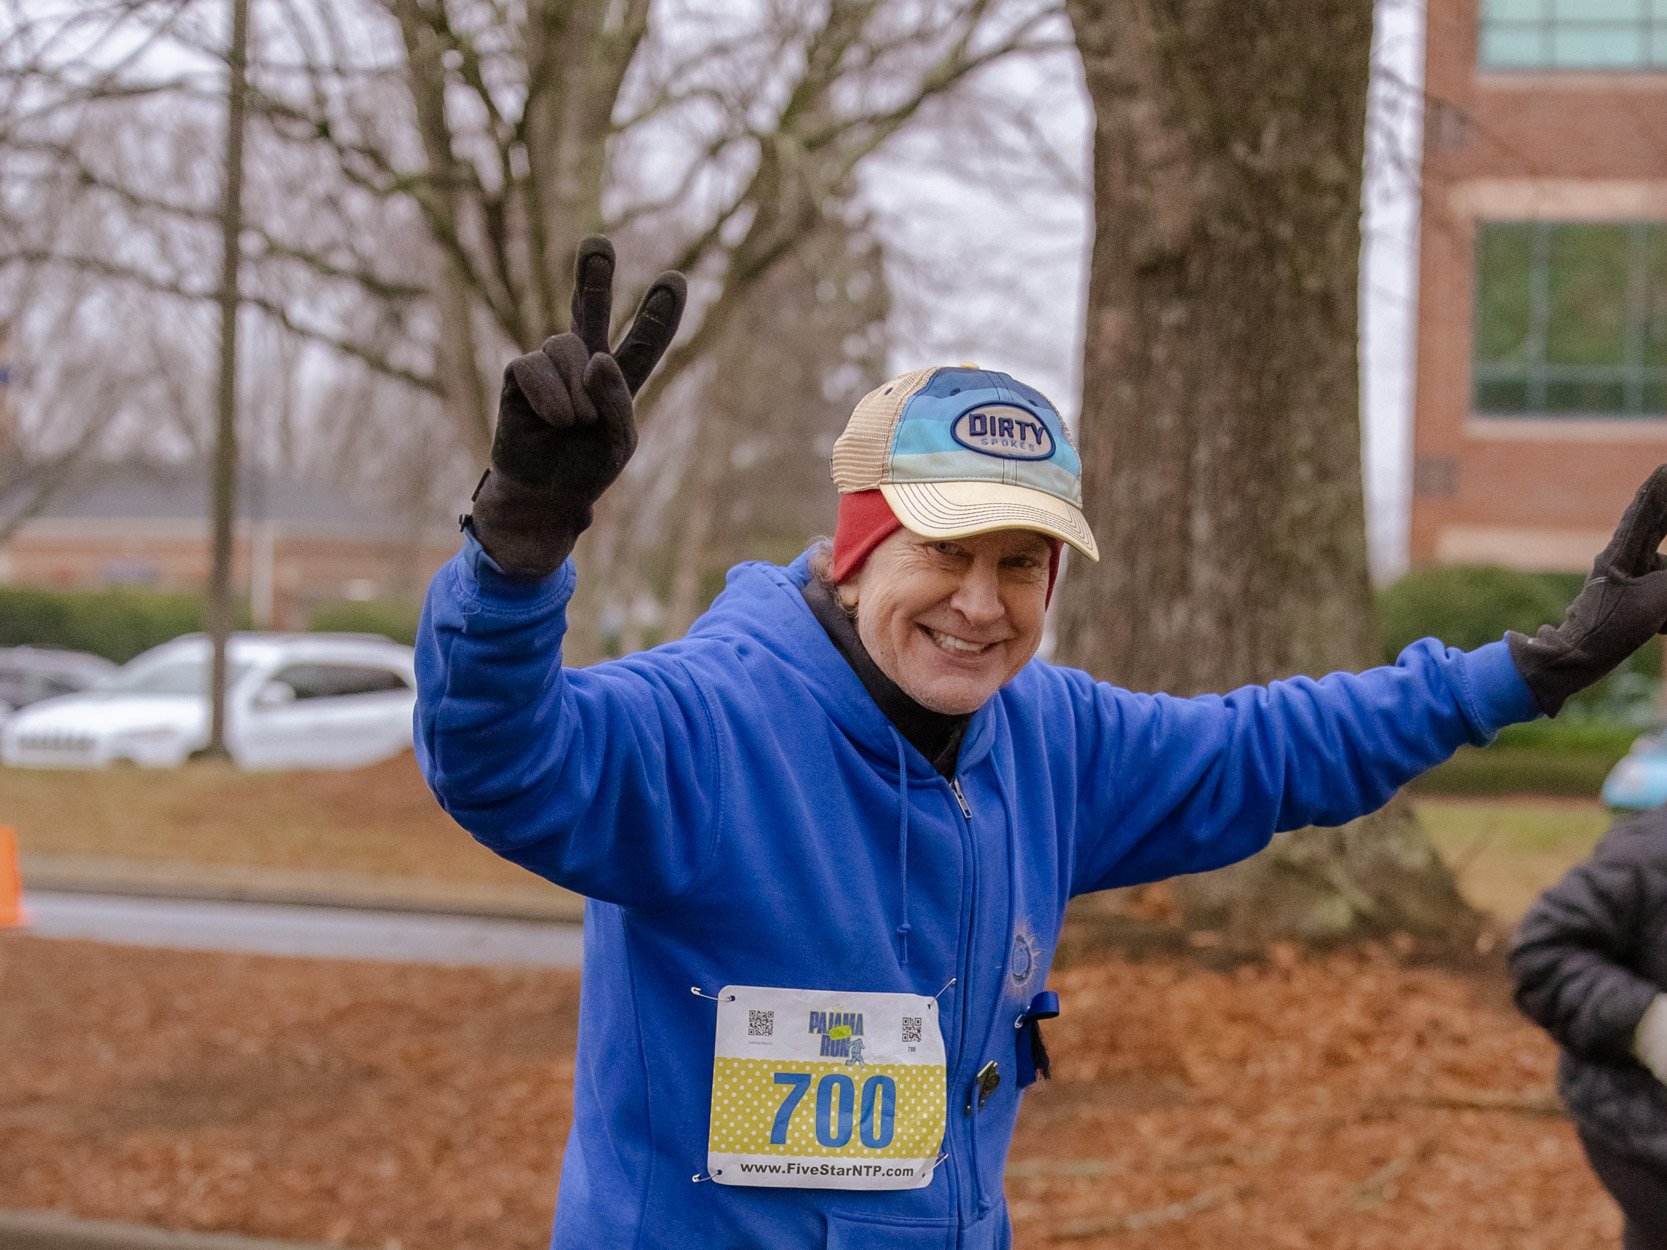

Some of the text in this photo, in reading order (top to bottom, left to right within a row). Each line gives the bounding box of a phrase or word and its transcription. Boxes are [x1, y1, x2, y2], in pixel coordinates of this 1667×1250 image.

[968, 413, 1045, 445] DIRTY
[981, 437, 1035, 452] SPOKES
[819, 1034, 850, 1057] RUN
[770, 1072, 896, 1149] 700
[740, 1162, 914, 1177] www.FiveStarNTP.com
